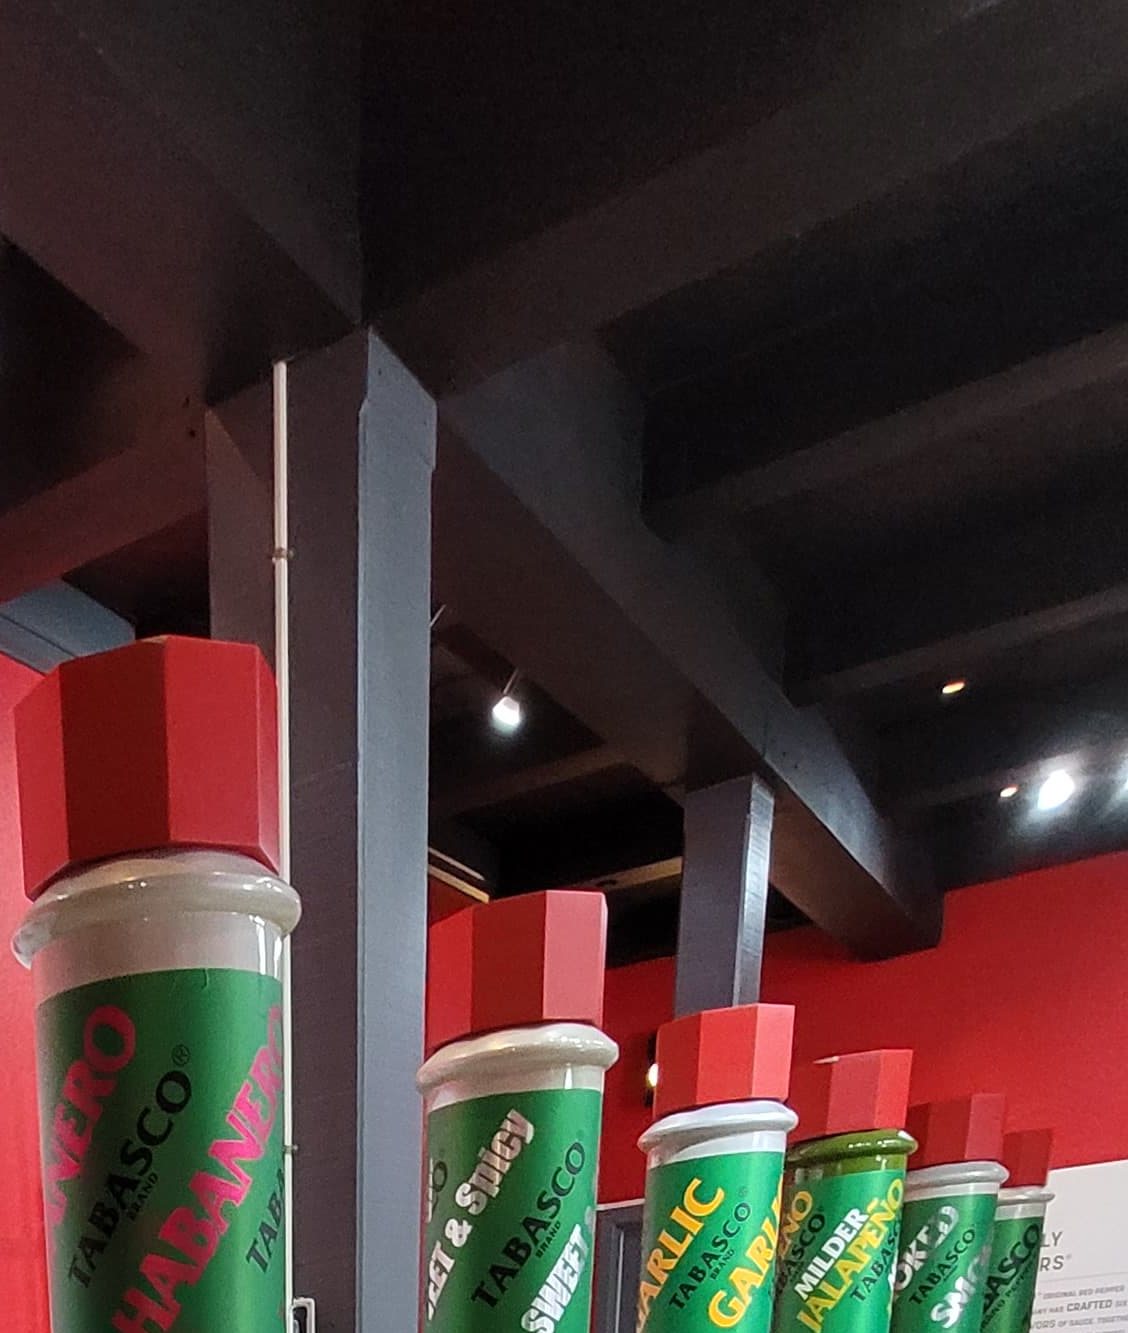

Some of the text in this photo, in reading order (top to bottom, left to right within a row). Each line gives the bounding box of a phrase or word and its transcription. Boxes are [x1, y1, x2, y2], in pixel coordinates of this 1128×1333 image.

[129, 1172, 159, 1221] BRAND
[472, 1141, 585, 1307] TABASCO
[669, 1202, 751, 1309] TABASCO
[794, 1208, 869, 1300] MILDER
[909, 1228, 975, 1304] TABASCO
[1067, 1300, 1112, 1311] CRAFTED
